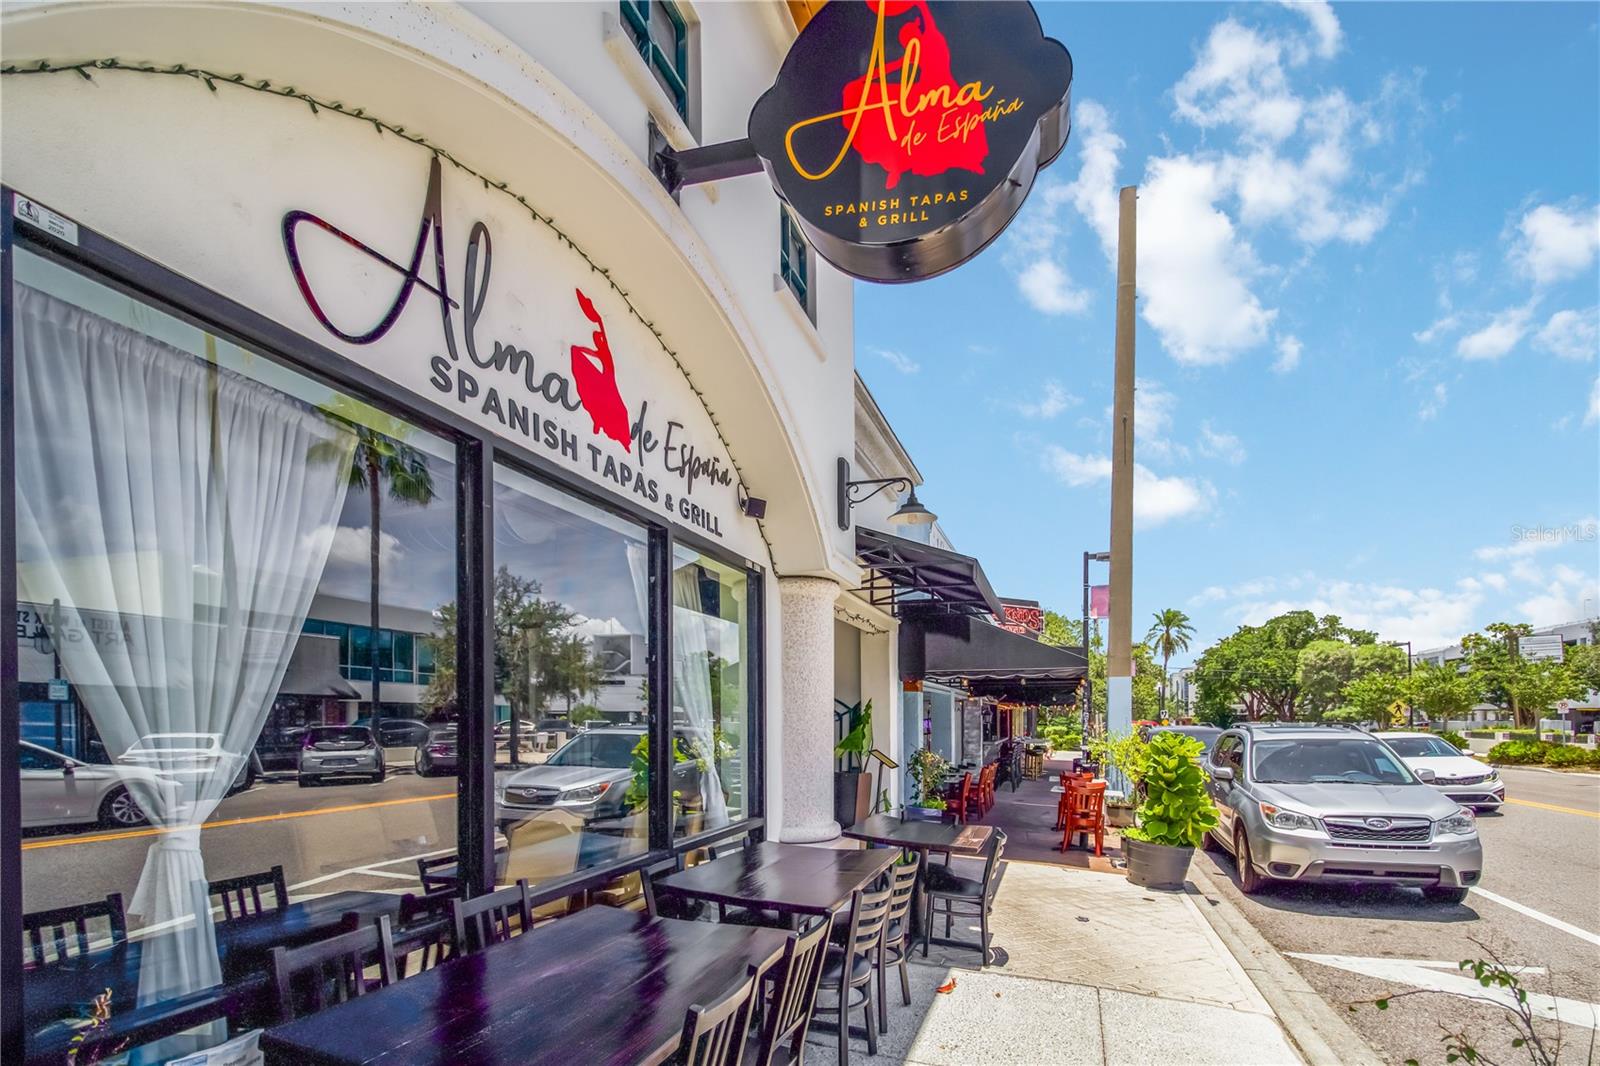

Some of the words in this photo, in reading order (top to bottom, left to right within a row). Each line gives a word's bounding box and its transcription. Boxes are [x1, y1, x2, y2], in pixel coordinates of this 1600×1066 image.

[785, 0, 994, 180] Alma
[901, 121, 926, 155] de
[937, 97, 1024, 143] España
[824, 198, 899, 216] SPANISH
[910, 190, 969, 207] TAPAS
[859, 217, 868, 228] &
[877, 210, 929, 226] GRILL
[281, 156, 583, 412] Alma
[430, 354, 578, 462] SPANISH
[587, 442, 658, 503] TAPAS
[665, 492, 674, 513] &
[679, 502, 723, 538] GRILL
[630, 401, 658, 467] de
[664, 420, 734, 494] España
